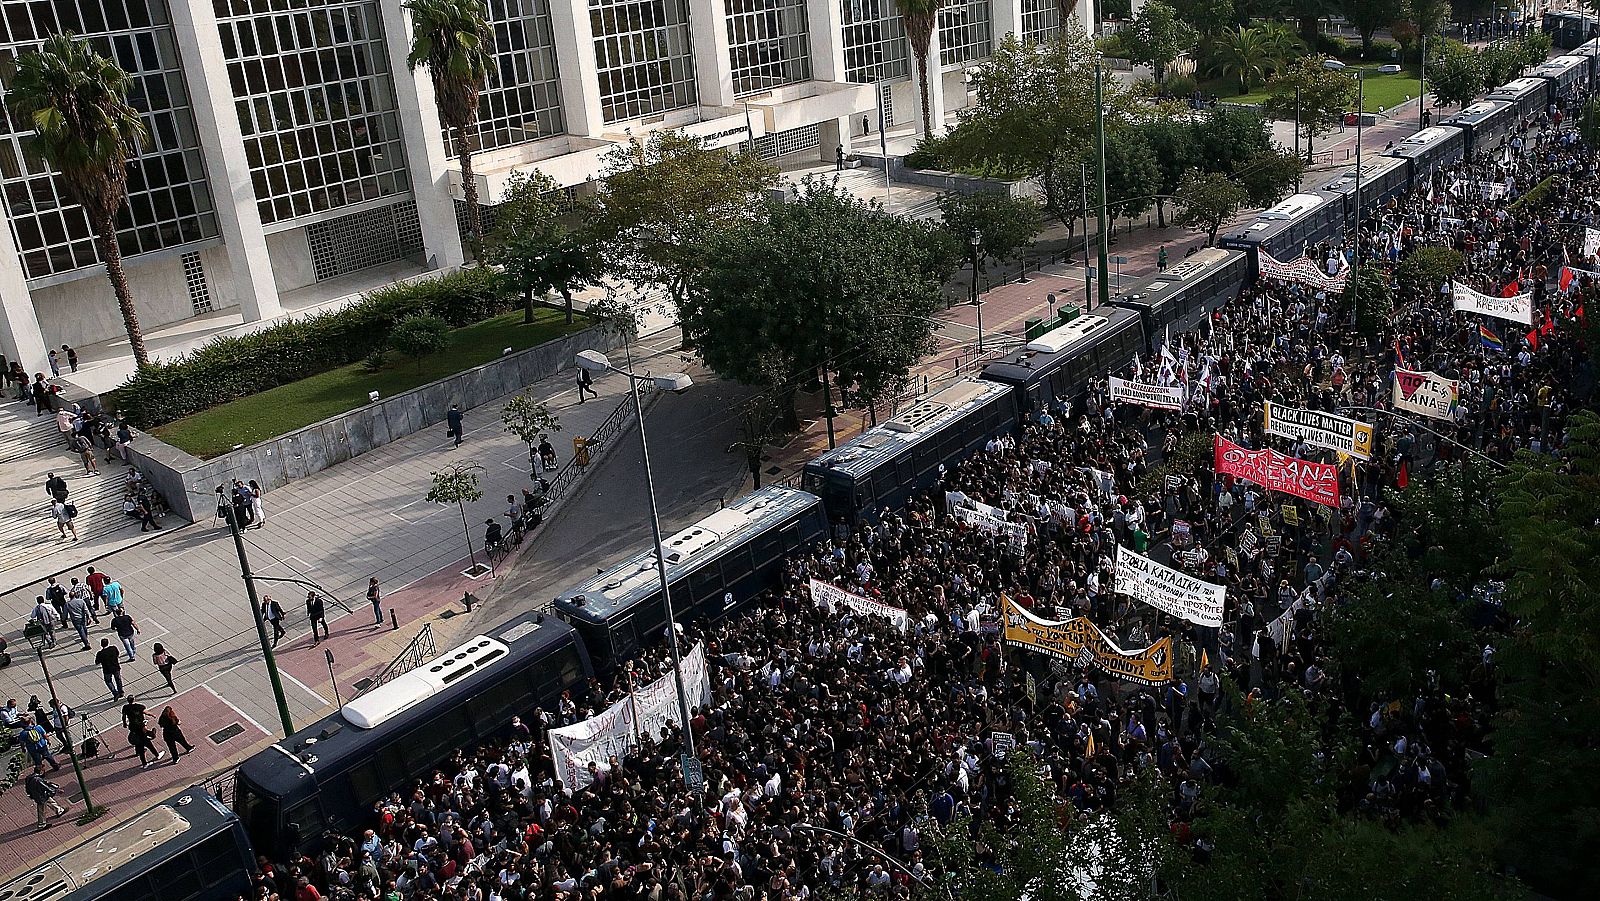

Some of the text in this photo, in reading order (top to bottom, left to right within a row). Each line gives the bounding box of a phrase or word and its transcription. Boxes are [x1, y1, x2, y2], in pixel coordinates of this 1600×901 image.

[1272, 407, 1352, 436] BLACK LIVES MATTER
[1304, 427, 1323, 442] LIVES
[1325, 431, 1353, 451] MATTER
[1150, 565, 1202, 593] ΚΑΤΑΔΙΚΗ
